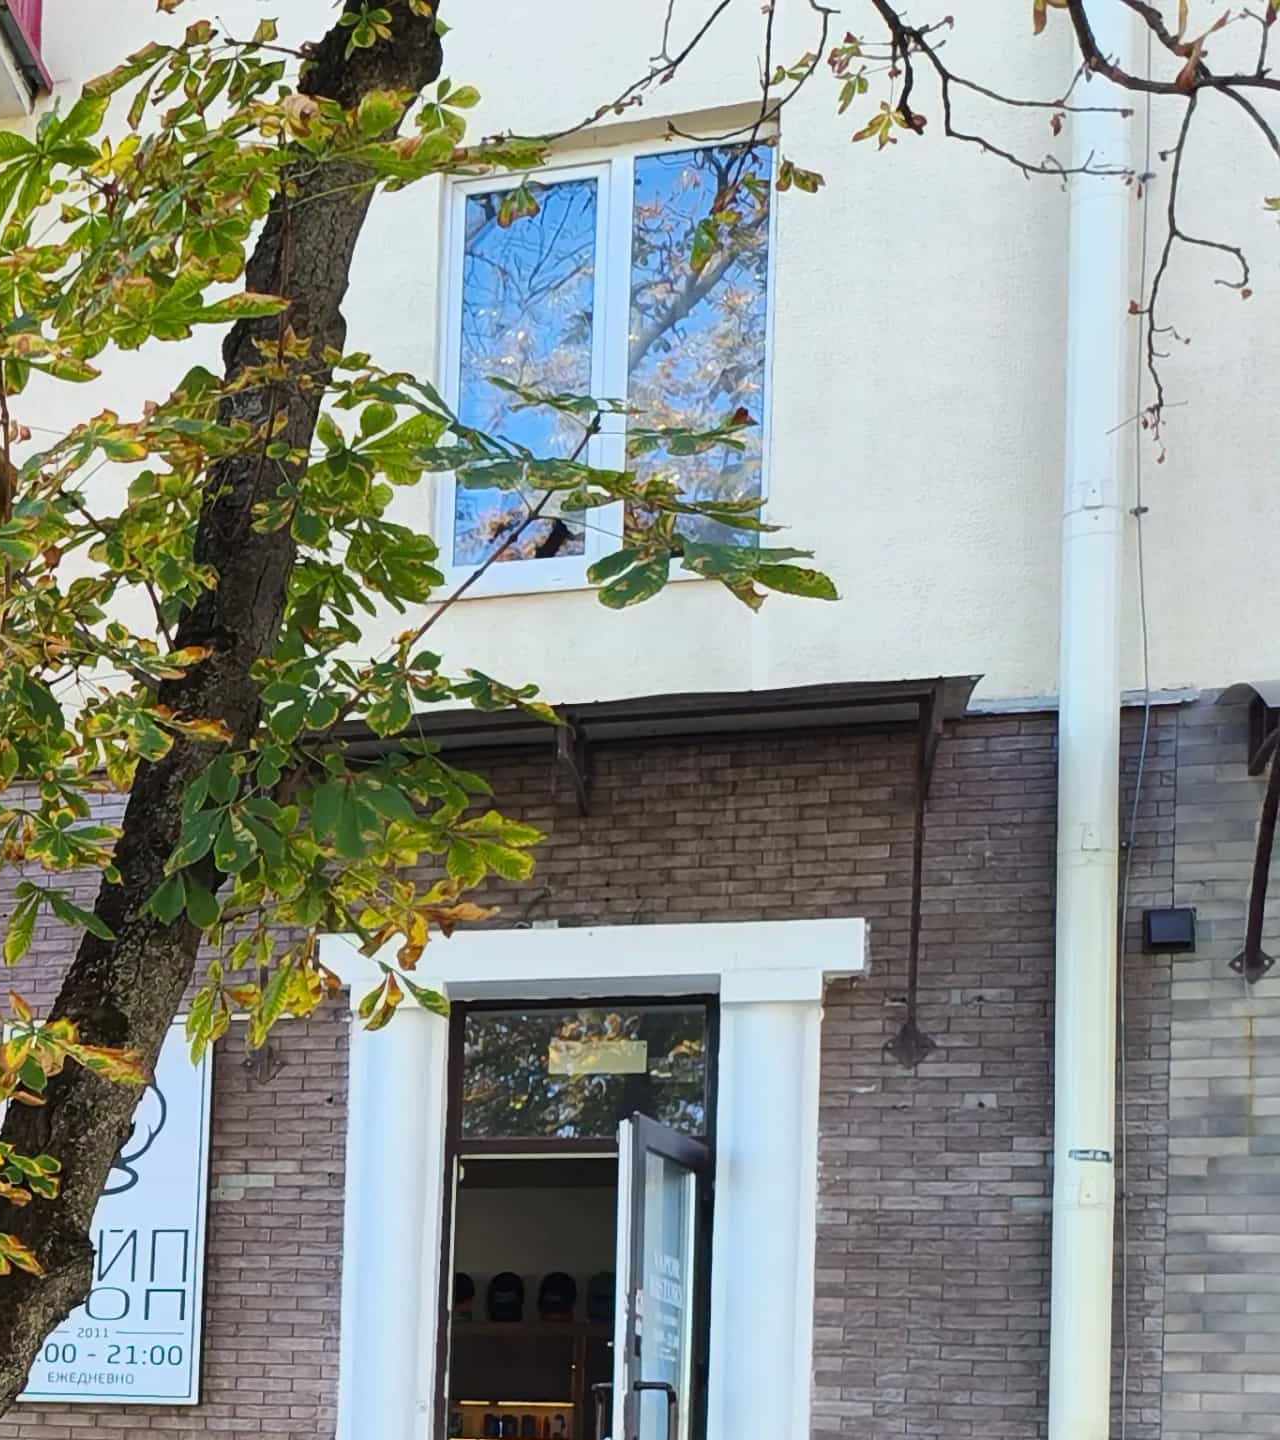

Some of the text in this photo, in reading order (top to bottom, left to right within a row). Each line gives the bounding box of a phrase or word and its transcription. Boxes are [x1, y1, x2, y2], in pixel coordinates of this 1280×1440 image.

[96, 1228, 190, 1283] ЙП
[85, 1286, 186, 1321] ОП
[76, 1327, 110, 1338] 2011
[106, 1344, 183, 1366] 21:00
[47, 1370, 135, 1387] ЕЖЕДНЕВНО
